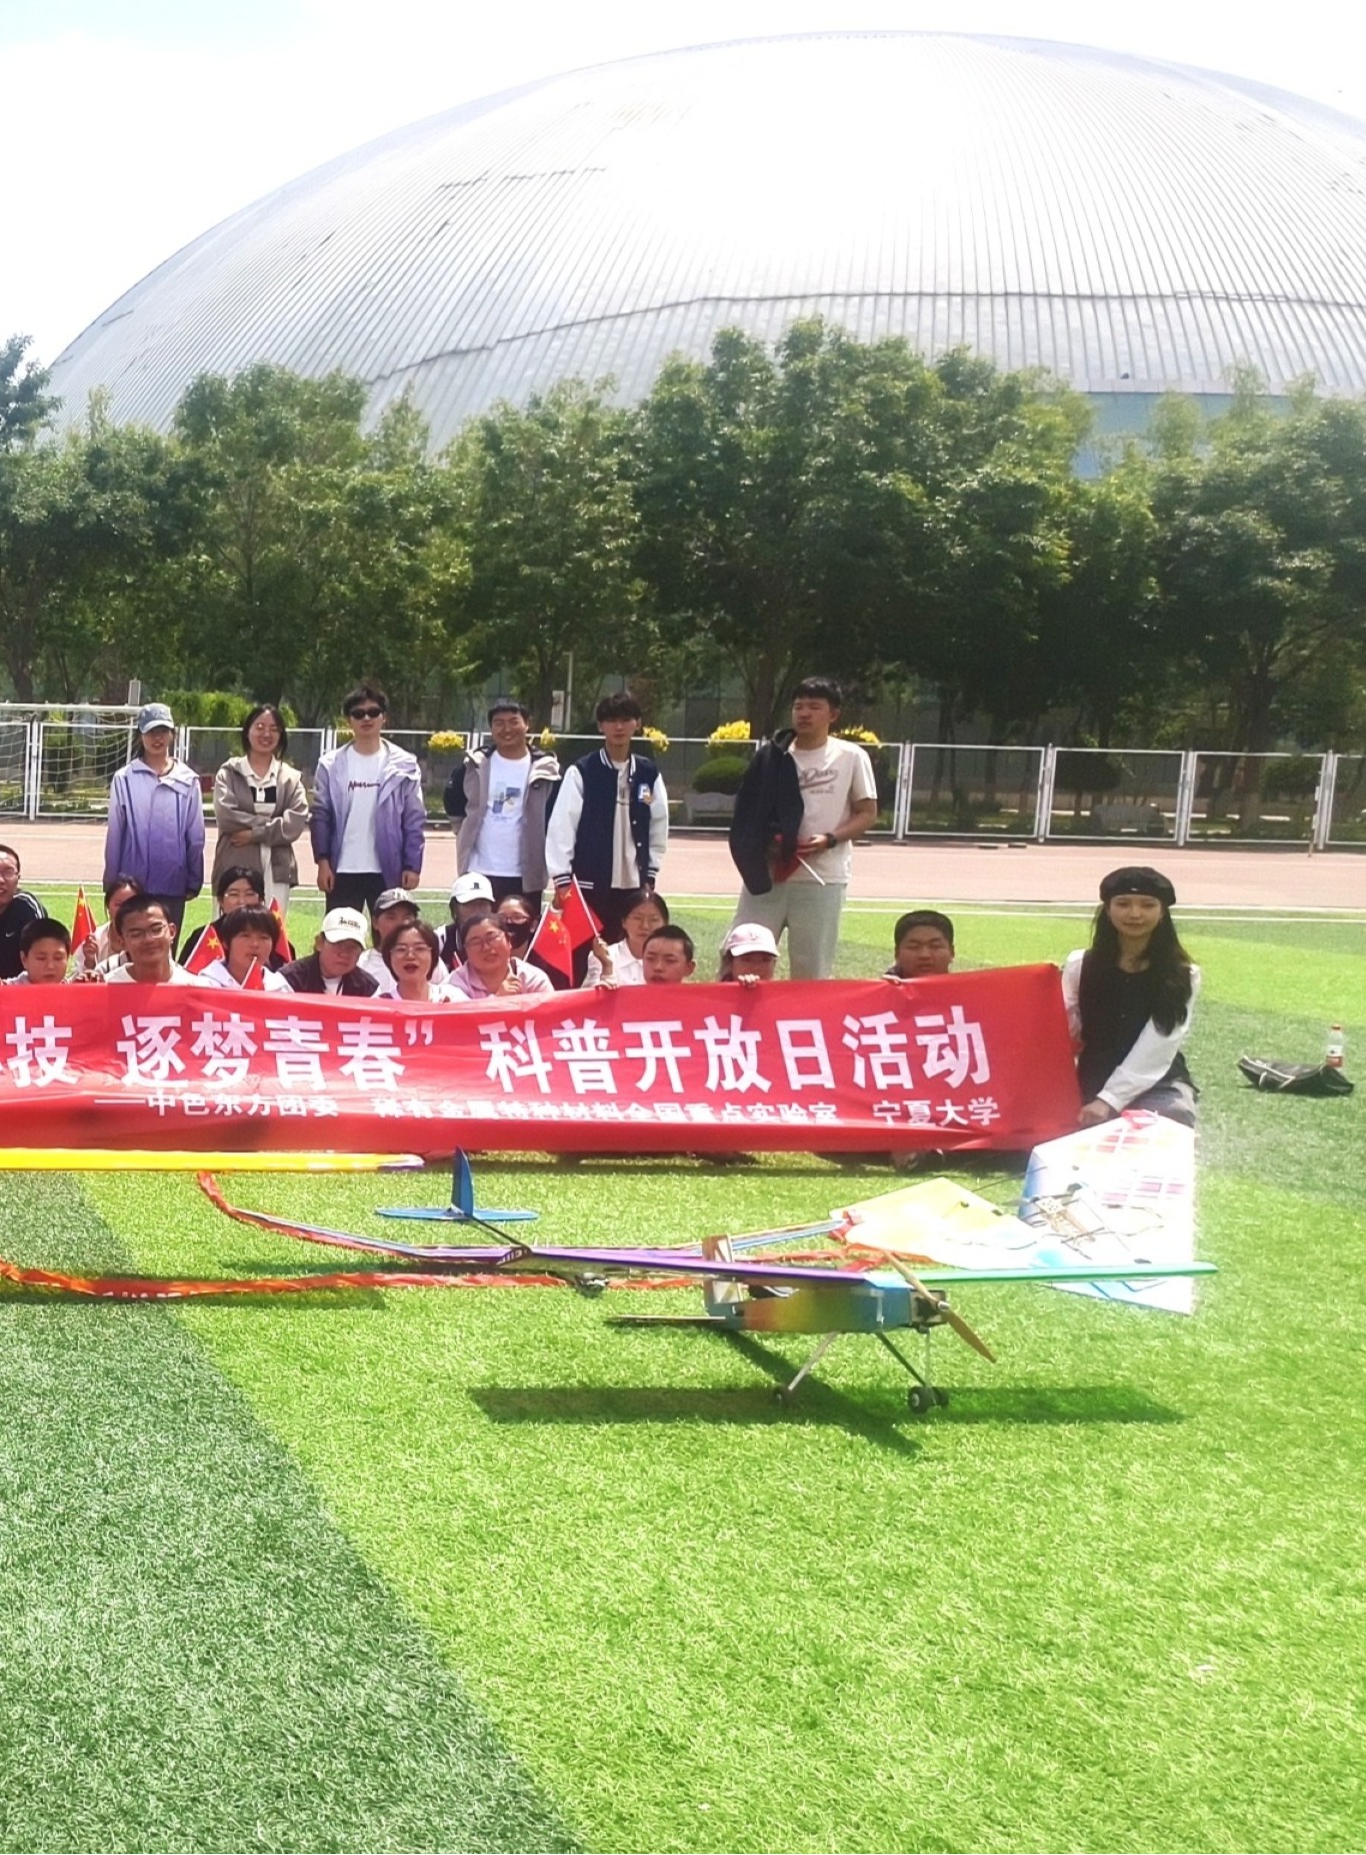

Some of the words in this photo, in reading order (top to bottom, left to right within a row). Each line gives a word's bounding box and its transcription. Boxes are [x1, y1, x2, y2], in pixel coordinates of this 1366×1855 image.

[117, 1011, 434, 1092] 逐梦青春”
[479, 1005, 991, 1094] 科普开放日活动
[873, 1096, 1001, 1127] 宁夏大学
